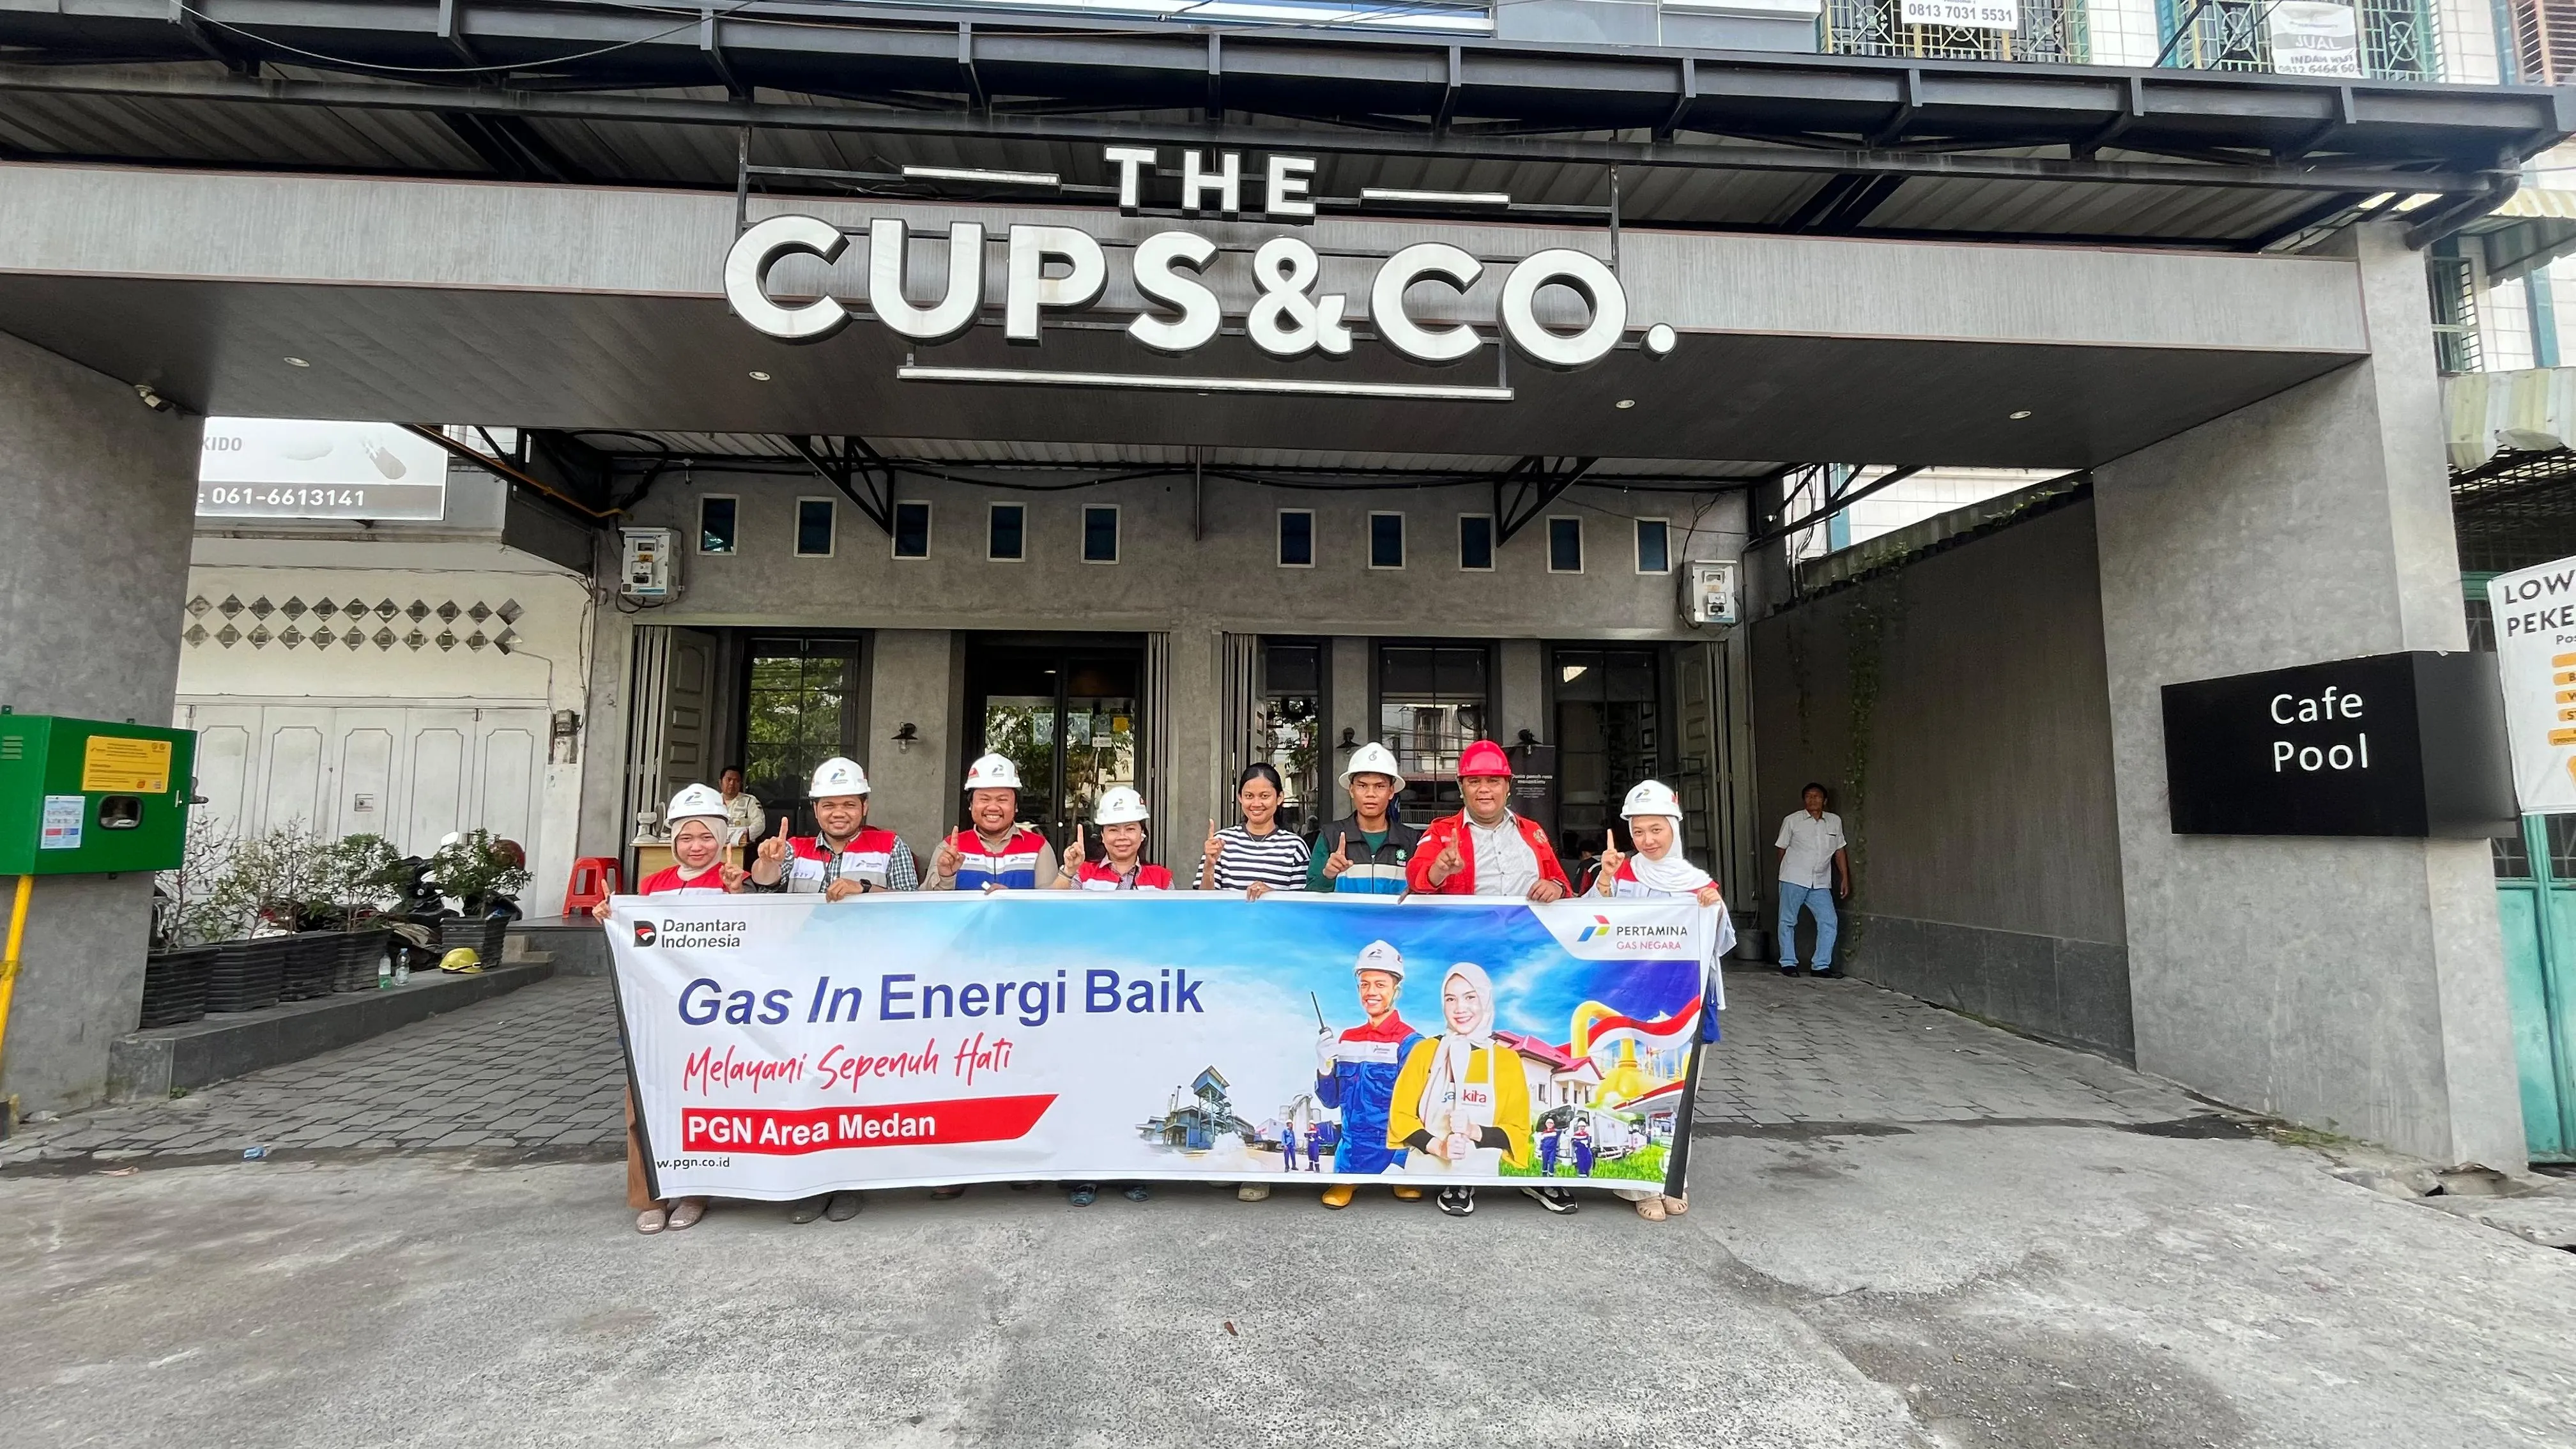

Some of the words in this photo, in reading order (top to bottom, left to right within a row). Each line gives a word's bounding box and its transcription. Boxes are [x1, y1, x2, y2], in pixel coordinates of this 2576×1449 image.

[1908, 3, 1941, 17] 0813
[1945, 6, 1976, 20] 7031
[1981, 8, 2012, 22] 5531
[2295, 35, 2342, 50] JUAL
[1104, 145, 1317, 219] THE
[723, 213, 1677, 366] CUPS&CO.
[212, 486, 365, 507] 061-6613141
[2504, 569, 2576, 605] LOW
[2506, 604, 2575, 637] PEKE
[2271, 686, 2363, 725] Cafe
[2273, 732, 2368, 772] Pool
[661, 934, 740, 948] Indonesia
[663, 919, 746, 932] Danantara
[1616, 926, 1688, 936] PERTAMINA
[1616, 941, 1637, 950] GAS
[1639, 941, 1682, 950] NEGARA
[678, 977, 793, 1026] Gas
[806, 976, 862, 1023] In
[879, 969, 1066, 1027] Energi
[1085, 969, 1204, 1013] Baik
[683, 1044, 808, 1096] Melayani
[816, 1038, 940, 1093] Sepenuh
[954, 1032, 1014, 1086] Hati
[687, 1116, 752, 1144] PGN
[758, 1117, 830, 1146] Area
[838, 1112, 936, 1140] Medan
